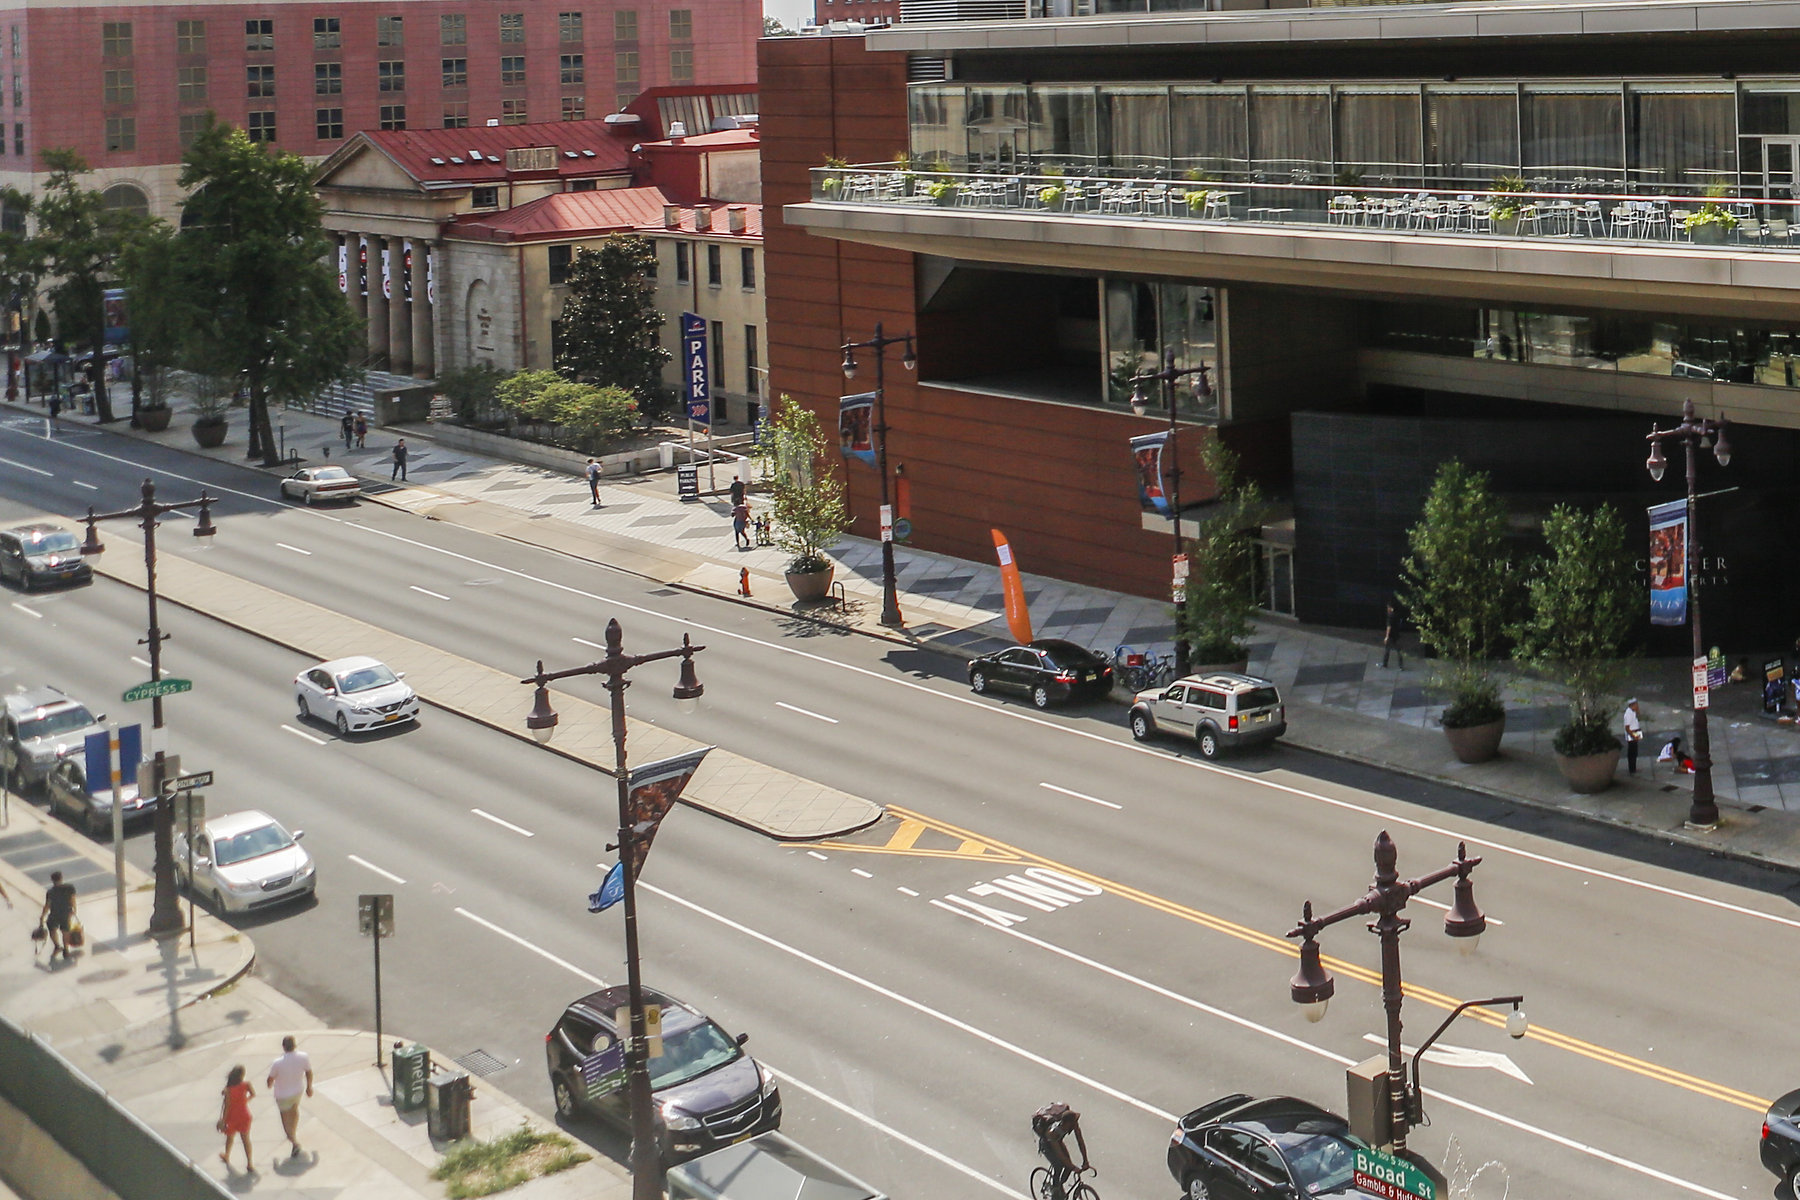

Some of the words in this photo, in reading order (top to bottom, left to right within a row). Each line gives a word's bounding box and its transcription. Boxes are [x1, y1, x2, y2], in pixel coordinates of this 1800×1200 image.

[691, 341, 705, 398] PARK
[126, 684, 177, 701] CYPRESS
[176, 779, 191, 788] ONE
[944, 867, 1103, 927] ONLY
[411, 1054, 425, 1104] metro
[1357, 1153, 1405, 1188] Broad
[1418, 1182, 1431, 1199] St
[1390, 1155, 1397, 1166] S
[1356, 1173, 1386, 1195] Gamble
[1388, 1186, 1395, 1198] &
